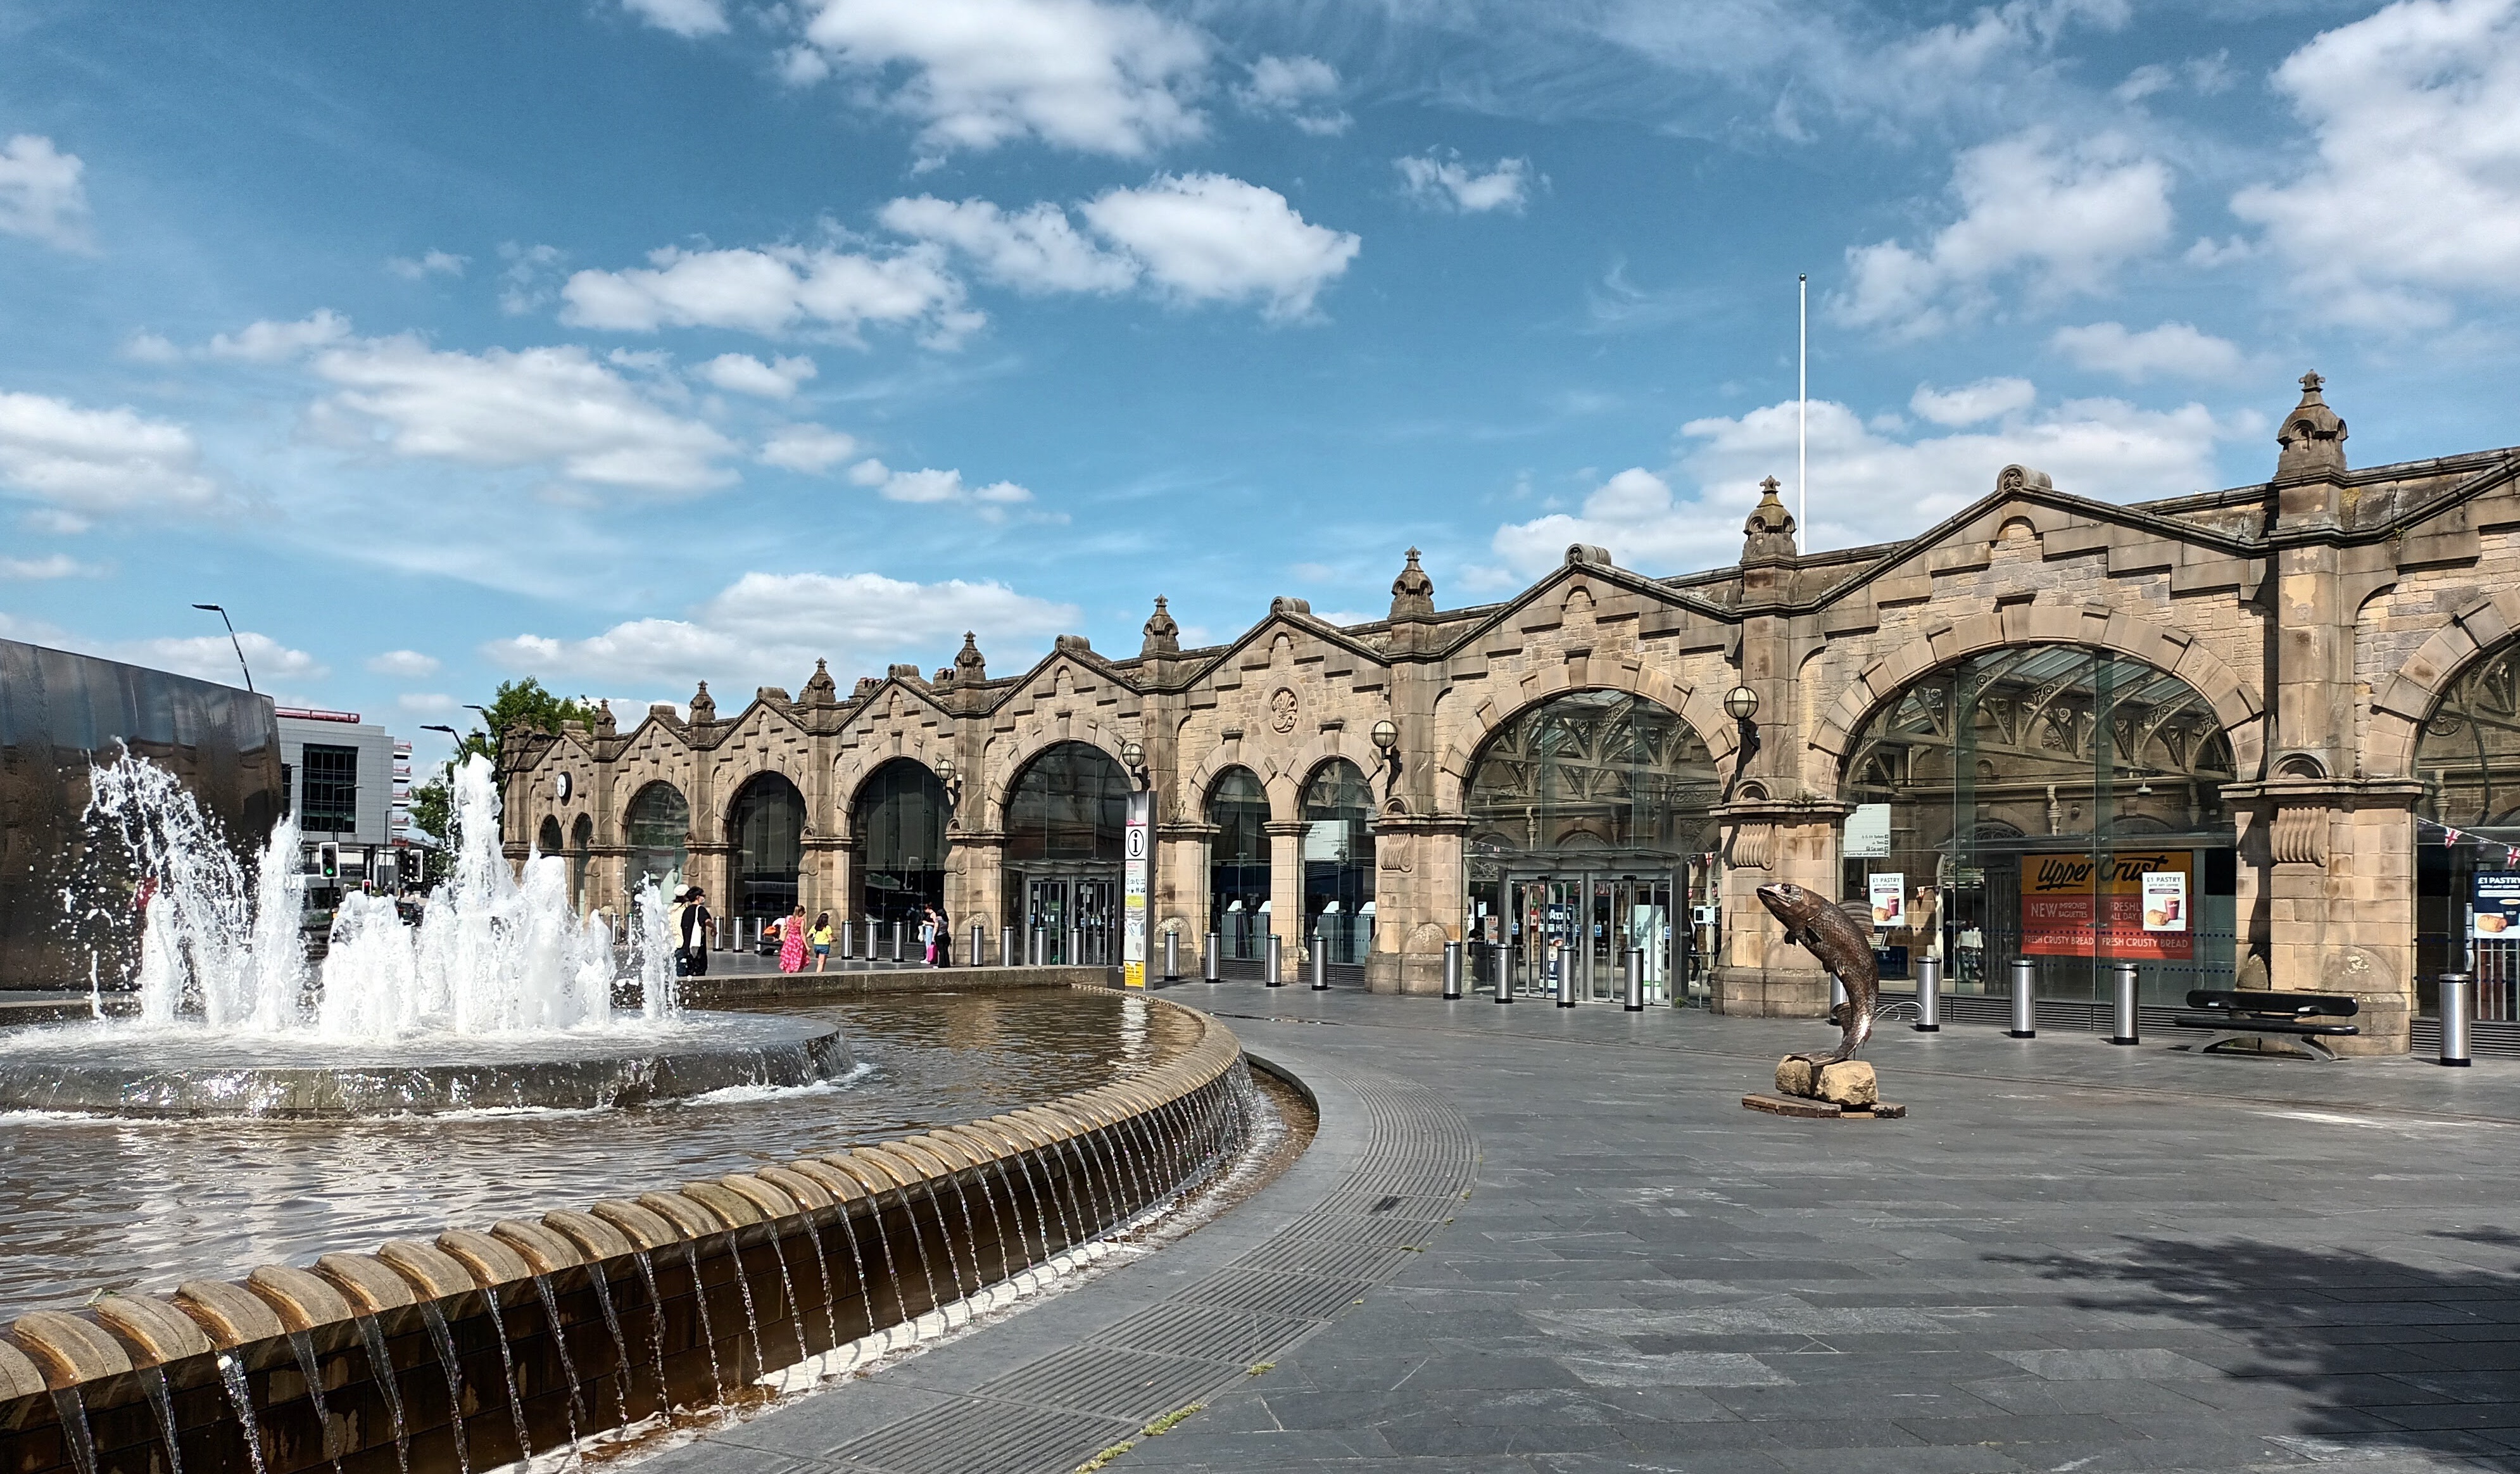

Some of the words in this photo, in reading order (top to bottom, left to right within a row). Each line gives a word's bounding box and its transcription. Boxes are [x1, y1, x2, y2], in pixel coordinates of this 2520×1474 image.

[2038, 859, 2094, 890] Upper
[2098, 855, 2169, 882] Crust
[2031, 903, 2058, 917] NEW
[2044, 936, 2070, 945] CRUSTY
[2102, 937, 2124, 946] FRESH
[2126, 938, 2158, 947] CRUSTY
[2160, 938, 2188, 948] BREAD
